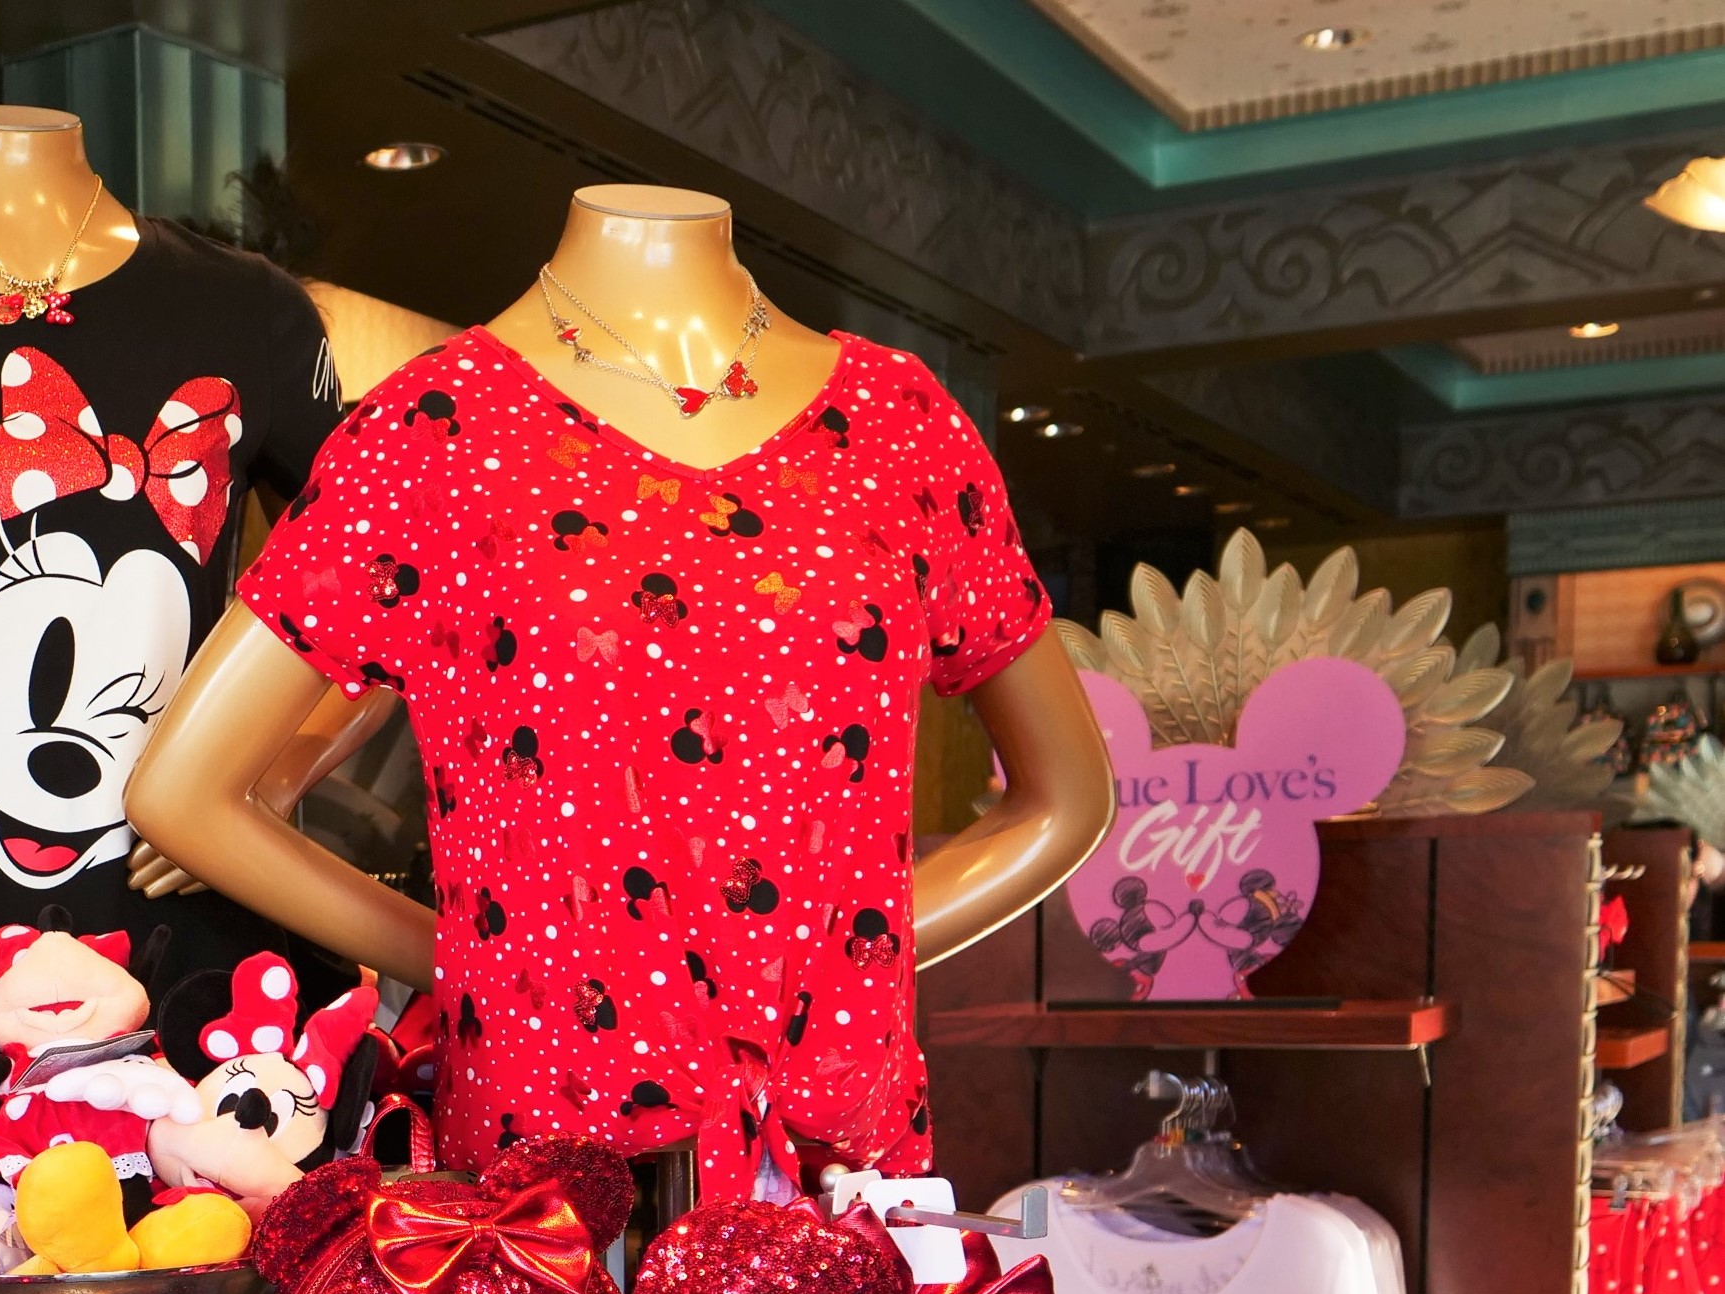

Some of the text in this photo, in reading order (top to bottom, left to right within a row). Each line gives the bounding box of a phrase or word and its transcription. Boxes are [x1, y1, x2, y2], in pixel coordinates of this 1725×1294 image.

[1115, 754, 1337, 807] ue Love's
[1119, 799, 1263, 892] Gift
